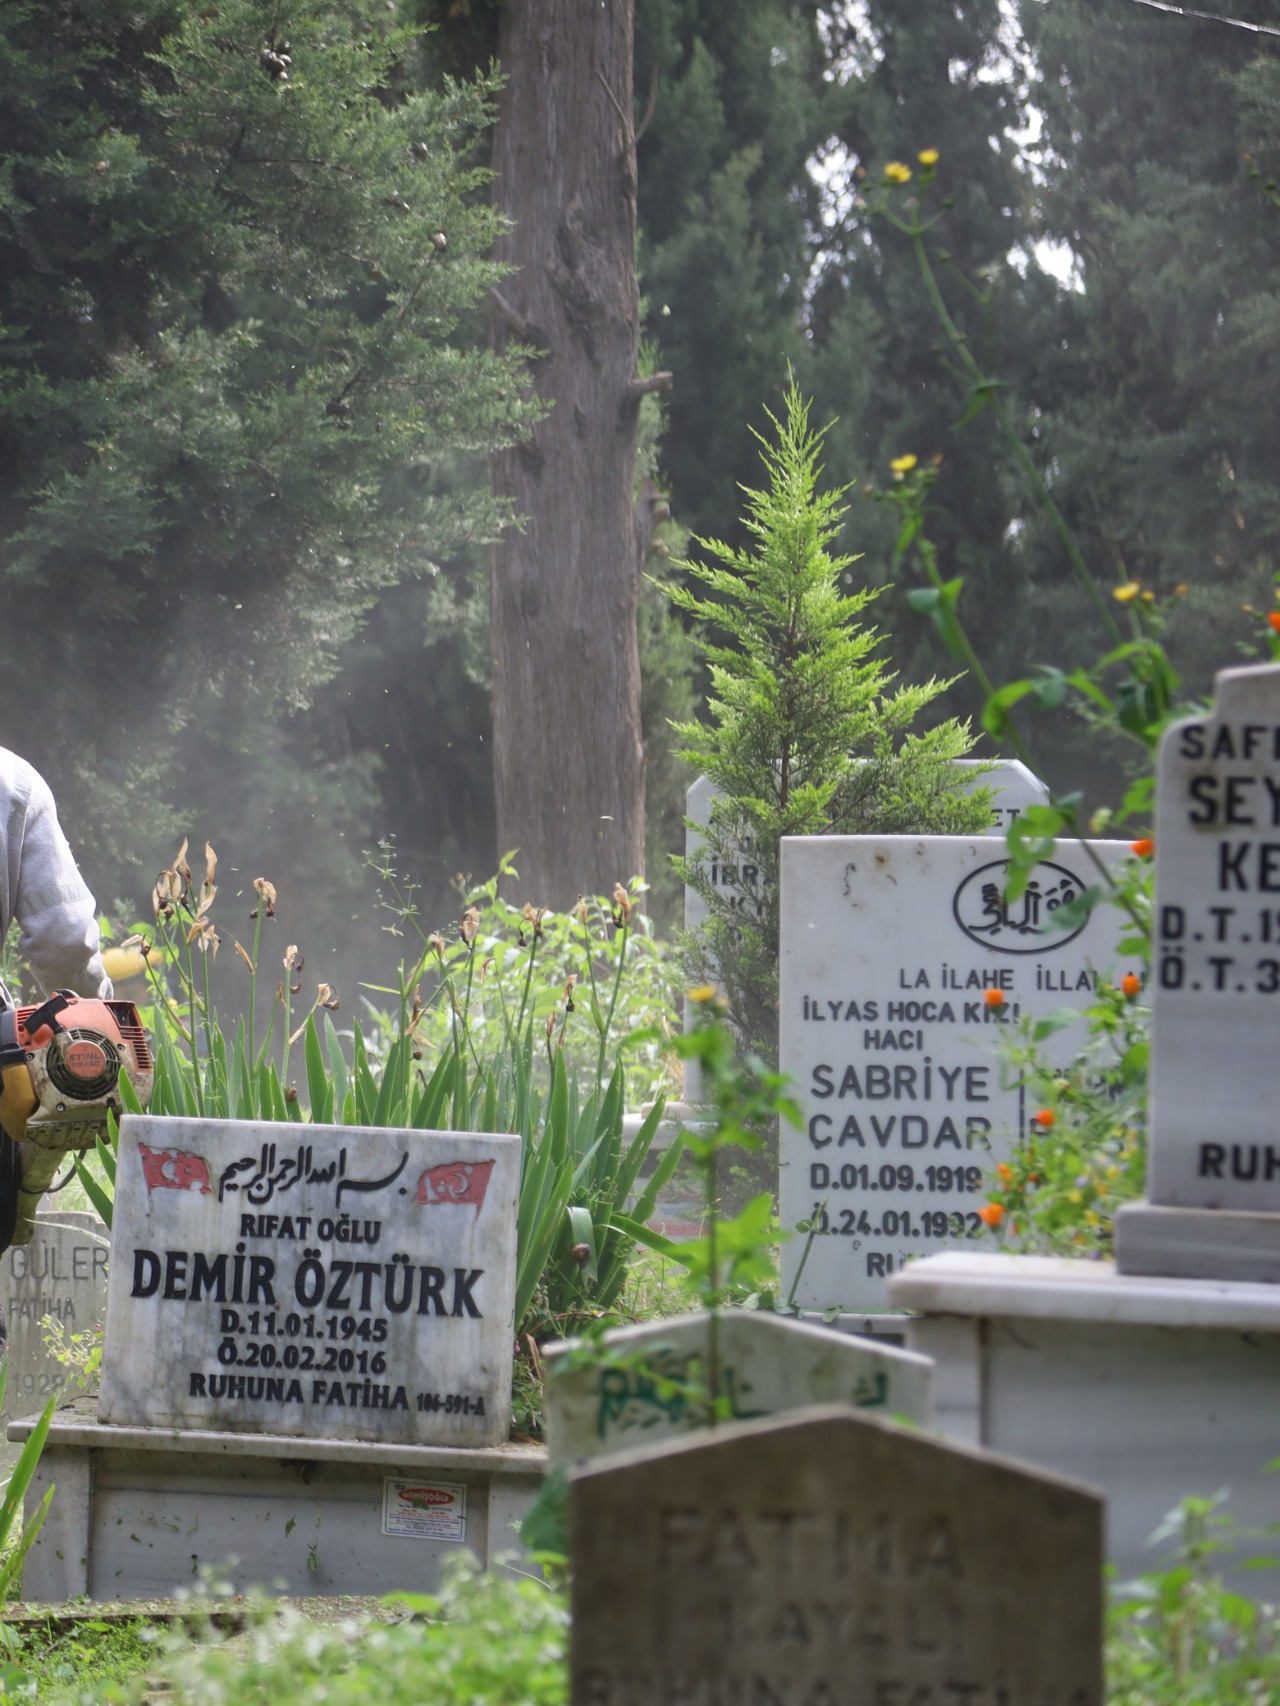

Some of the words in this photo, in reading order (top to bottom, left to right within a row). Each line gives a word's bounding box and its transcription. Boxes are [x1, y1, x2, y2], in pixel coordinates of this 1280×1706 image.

[899, 967, 930, 990] LA
[942, 963, 1014, 991] İLAHE
[803, 995, 879, 1022] İLYAS
[888, 1001, 956, 1024] HOCA
[864, 1029, 923, 1051] HACI
[811, 1057, 990, 1101] SABRİYE
[809, 1113, 992, 1150] ÇAVDAR
[810, 1162, 983, 1193] D.01.09.1919
[240, 1214, 311, 1239] RIFAT
[317, 1214, 382, 1244] OĞLU
[130, 1242, 276, 1305] DEMİR
[295, 1248, 486, 1319] ÖZTÜRK
[8, 1293, 76, 1320] FATİHA
[220, 1309, 388, 1342] D.11.01.1945
[218, 1337, 387, 1374] Ö.20.02.2016
[189, 1373, 304, 1404] RUHUNA
[312, 1379, 410, 1410] FATİHA
